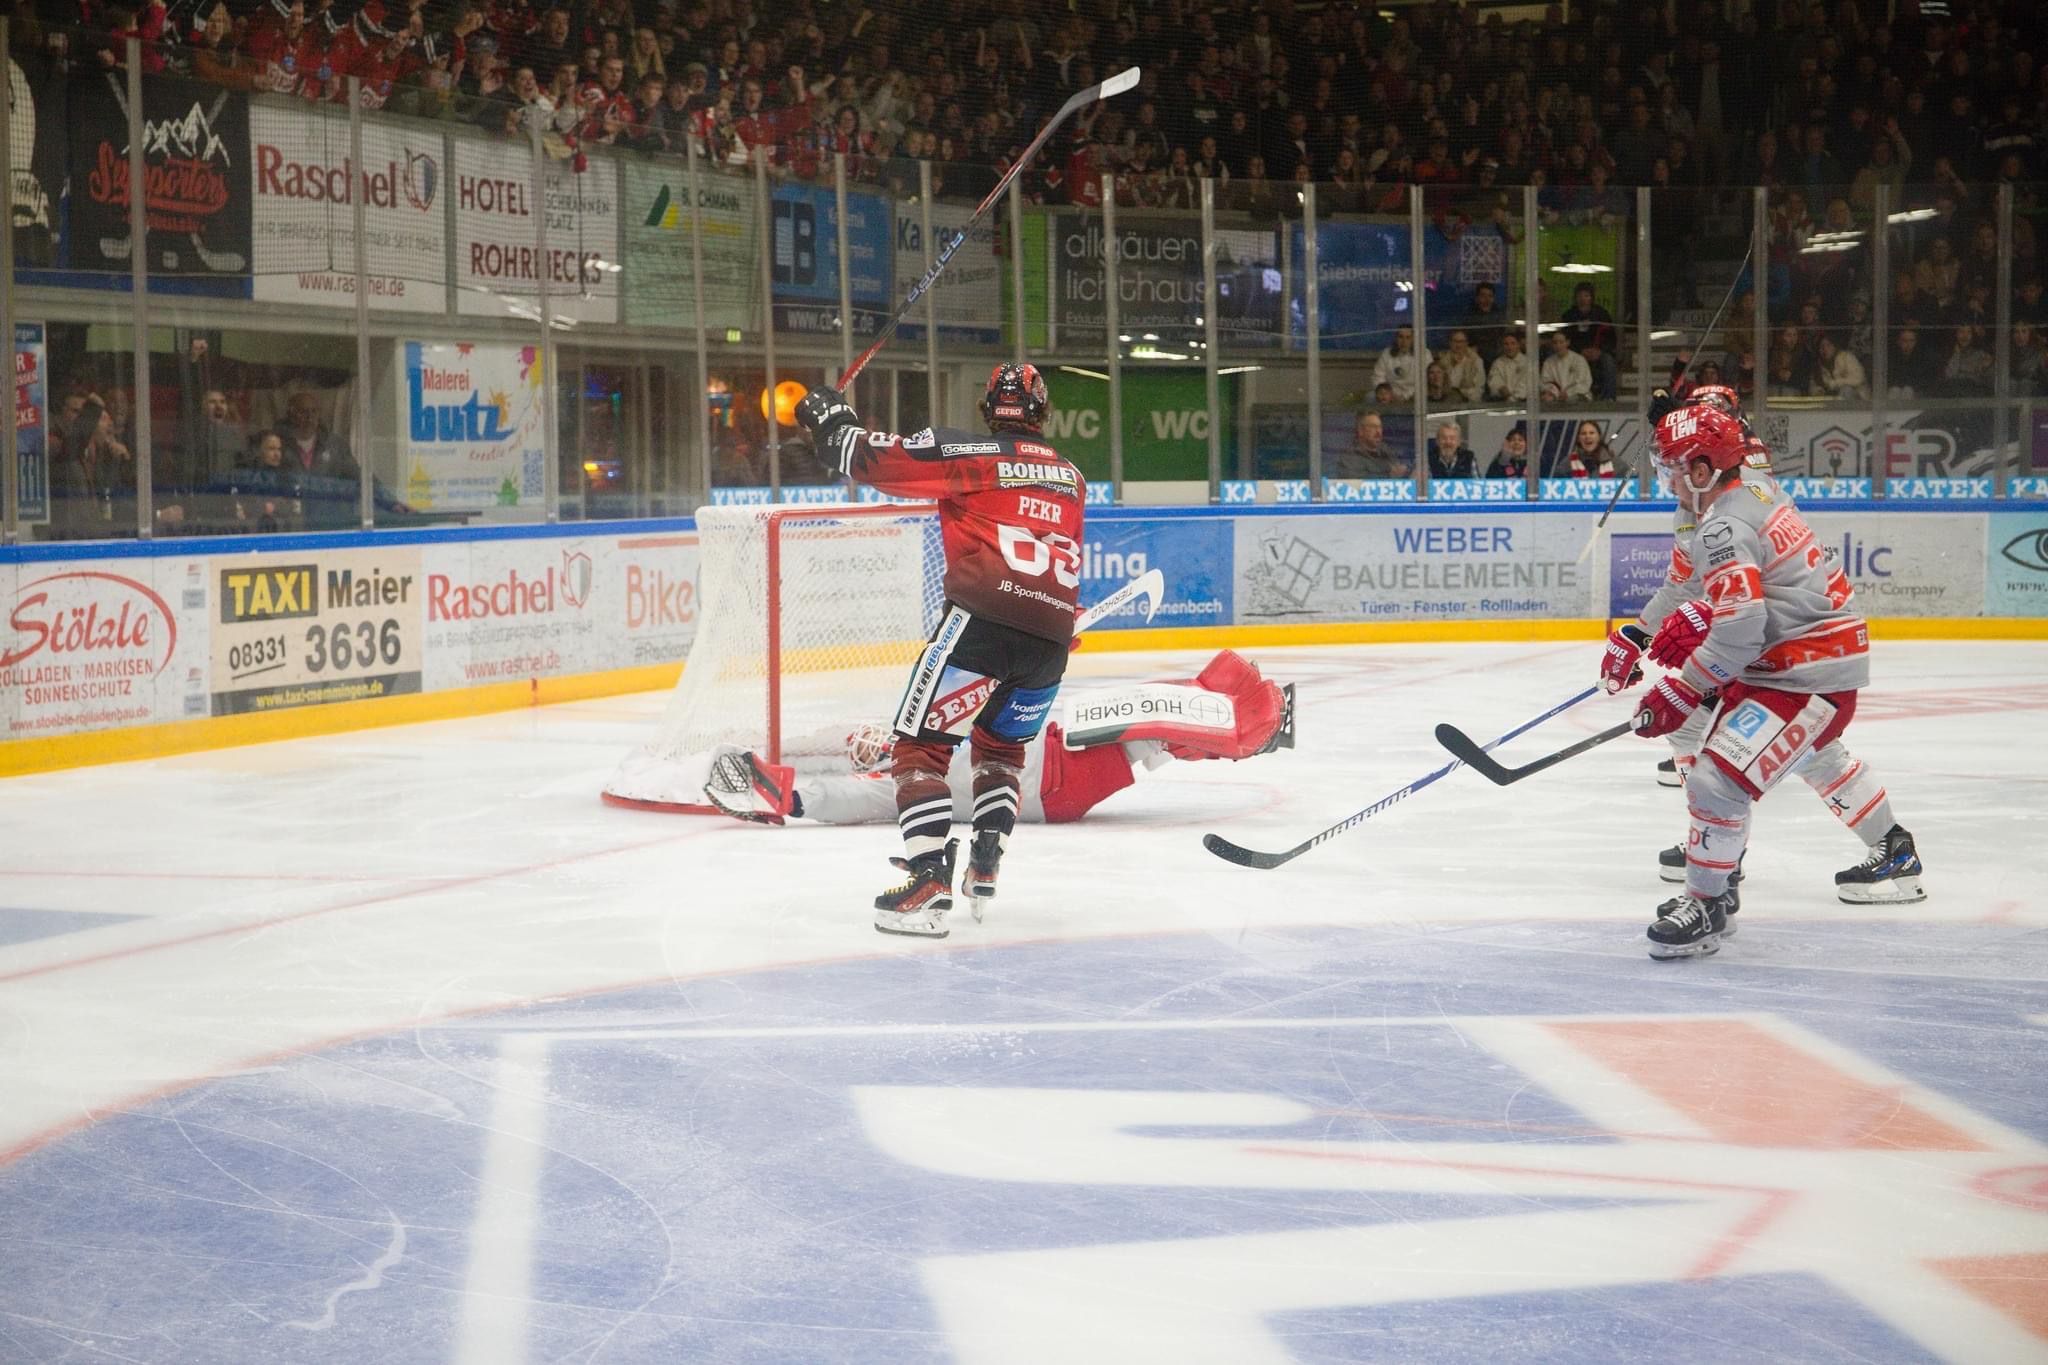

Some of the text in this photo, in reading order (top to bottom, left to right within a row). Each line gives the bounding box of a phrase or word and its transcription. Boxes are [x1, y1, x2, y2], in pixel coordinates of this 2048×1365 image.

[257, 144, 397, 209] Raschel
[460, 176, 529, 216] HOTEL
[1319, 262, 1442, 281] Siebendäcer
[298, 272, 406, 297] www.rashel.de
[405, 341, 517, 442] butz
[424, 369, 470, 391] Malerei
[1043, 409, 1100, 439] WC
[1152, 410, 1209, 440] WC
[1665, 409, 1689, 428] LEW
[1672, 417, 1697, 441] LEW
[1224, 482, 1309, 501] KAEK
[1327, 480, 1412, 500] KATEK
[1432, 480, 1526, 500] KATEK
[1543, 480, 1638, 500] KATEK
[1776, 478, 1867, 499] KATEK
[1890, 479, 1990, 499] KATEK
[1018, 495, 1062, 524] PEKR
[1394, 526, 1514, 554] WEBER
[998, 579, 1013, 593] JB
[1332, 562, 1578, 591] BAUELEMENTE
[228, 568, 412, 617] TAXI Maier
[428, 566, 554, 622] Raschel
[1880, 582, 1947, 598] Company
[1138, 598, 1222, 615] Gönenbach
[1414, 600, 1467, 614] Fenster
[0, 592, 150, 667] Stölzle
[229, 619, 401, 673] 08331 3636
[84, 658, 153, 680] MARKISEN
[464, 650, 560, 679] www.raschel.de
[25, 680, 132, 706] SONNENSCHUTZ
[925, 678, 1001, 730] GEFRO
[1075, 699, 1182, 724] HUG GMBH
[1758, 723, 1807, 783] ALD
